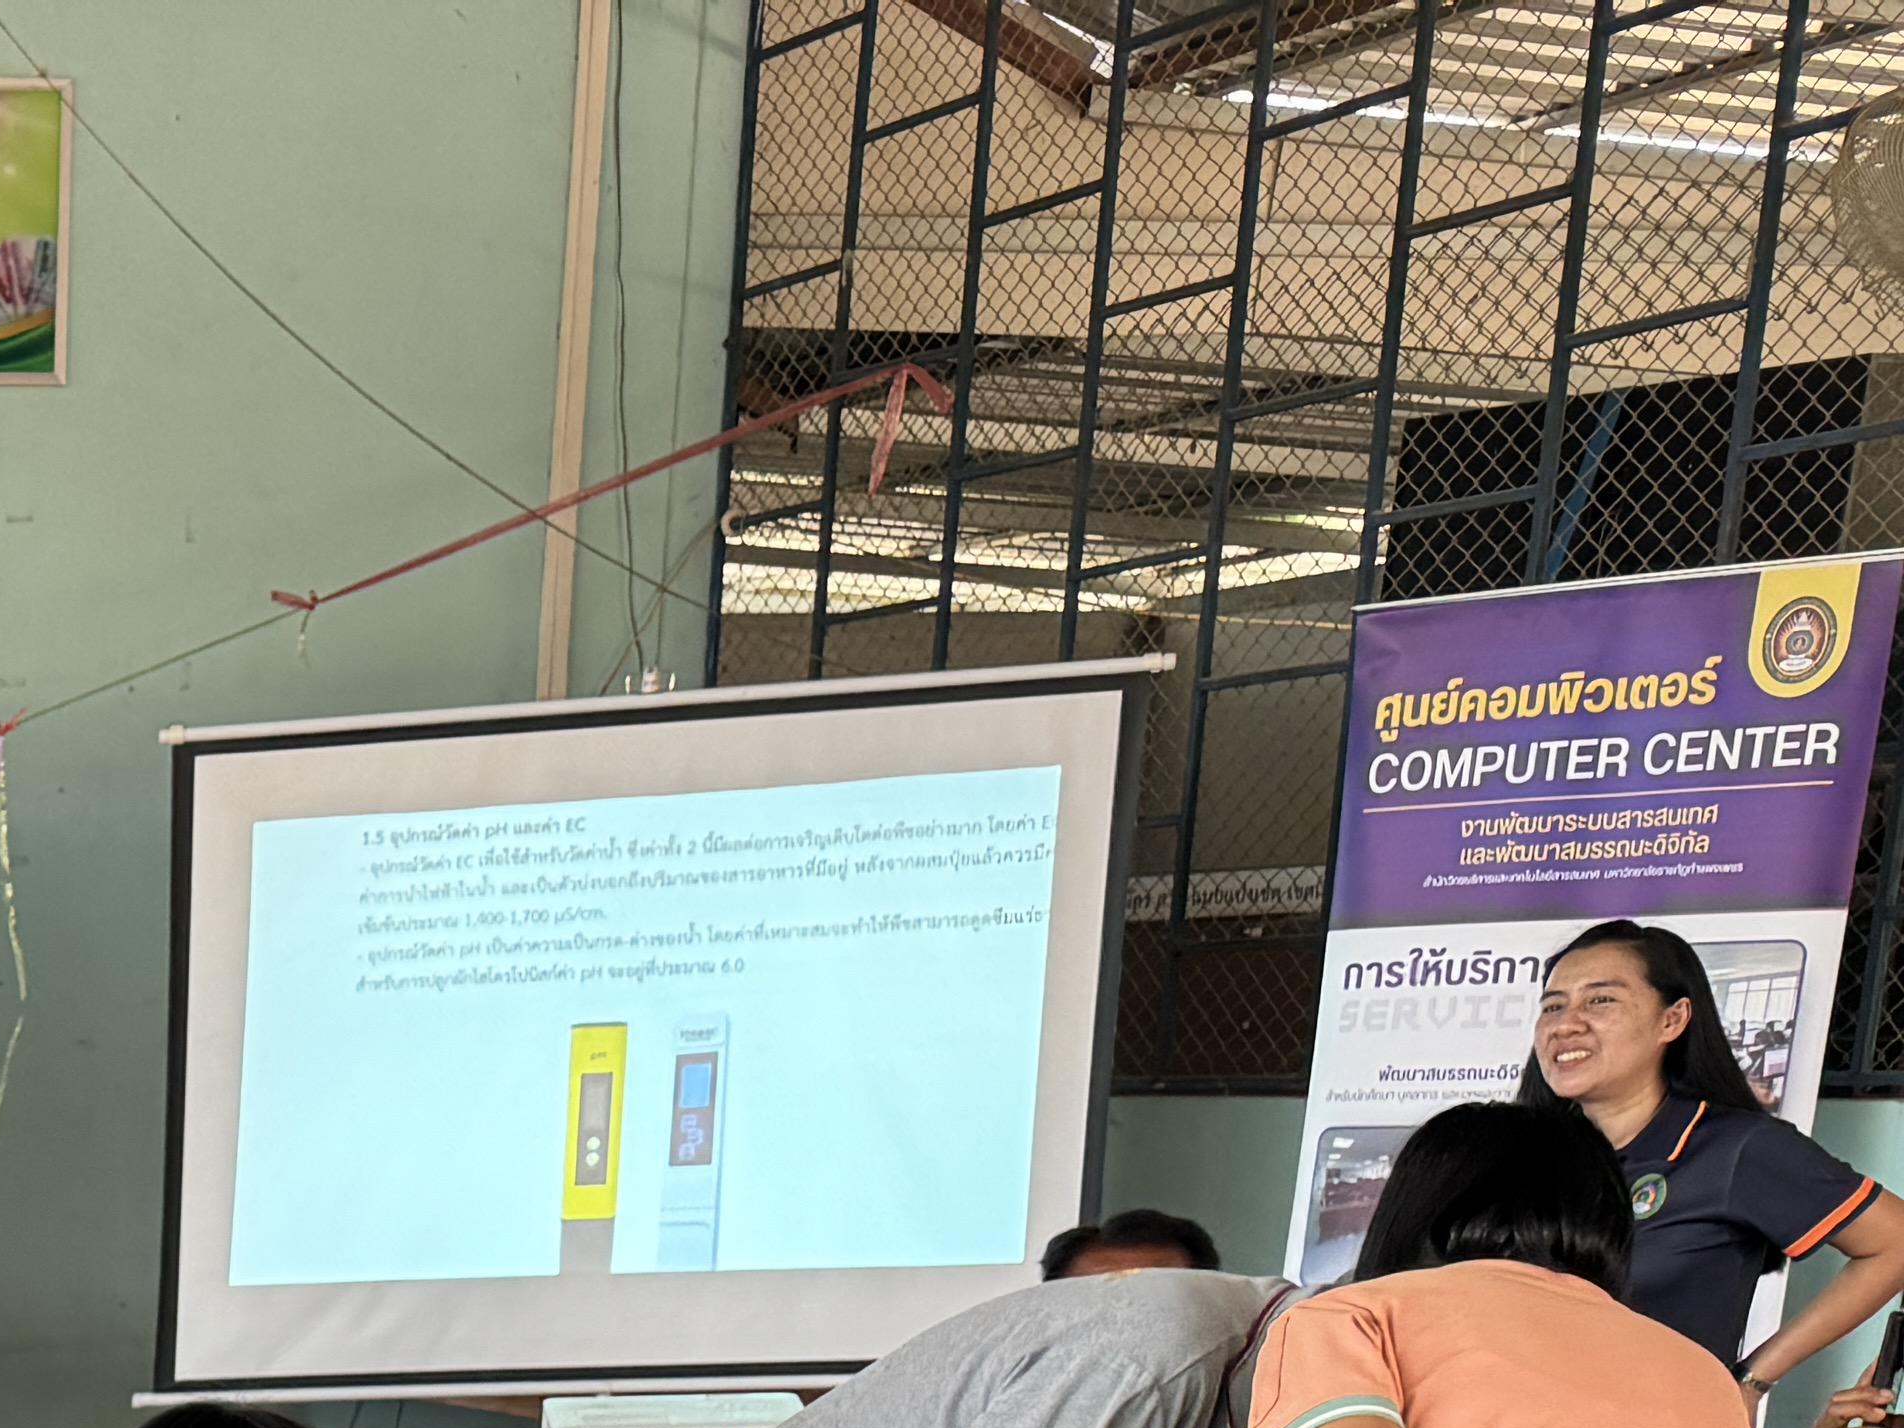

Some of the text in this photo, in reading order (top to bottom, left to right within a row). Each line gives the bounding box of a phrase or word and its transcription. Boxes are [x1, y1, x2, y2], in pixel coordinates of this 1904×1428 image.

[1374, 656, 1723, 744] ศูนย์คอมพิวเตอร์
[1368, 721, 1841, 796] COMPUTER CENTER
[1460, 803, 1720, 839] งานพัฒนาระบบสารสนเทศ
[1459, 831, 1712, 867] และพัฒนาสมรรถนะดิจิทัล
[1343, 947, 1550, 991] การให้บริกา
[1338, 993, 1535, 1034] SERVIC
